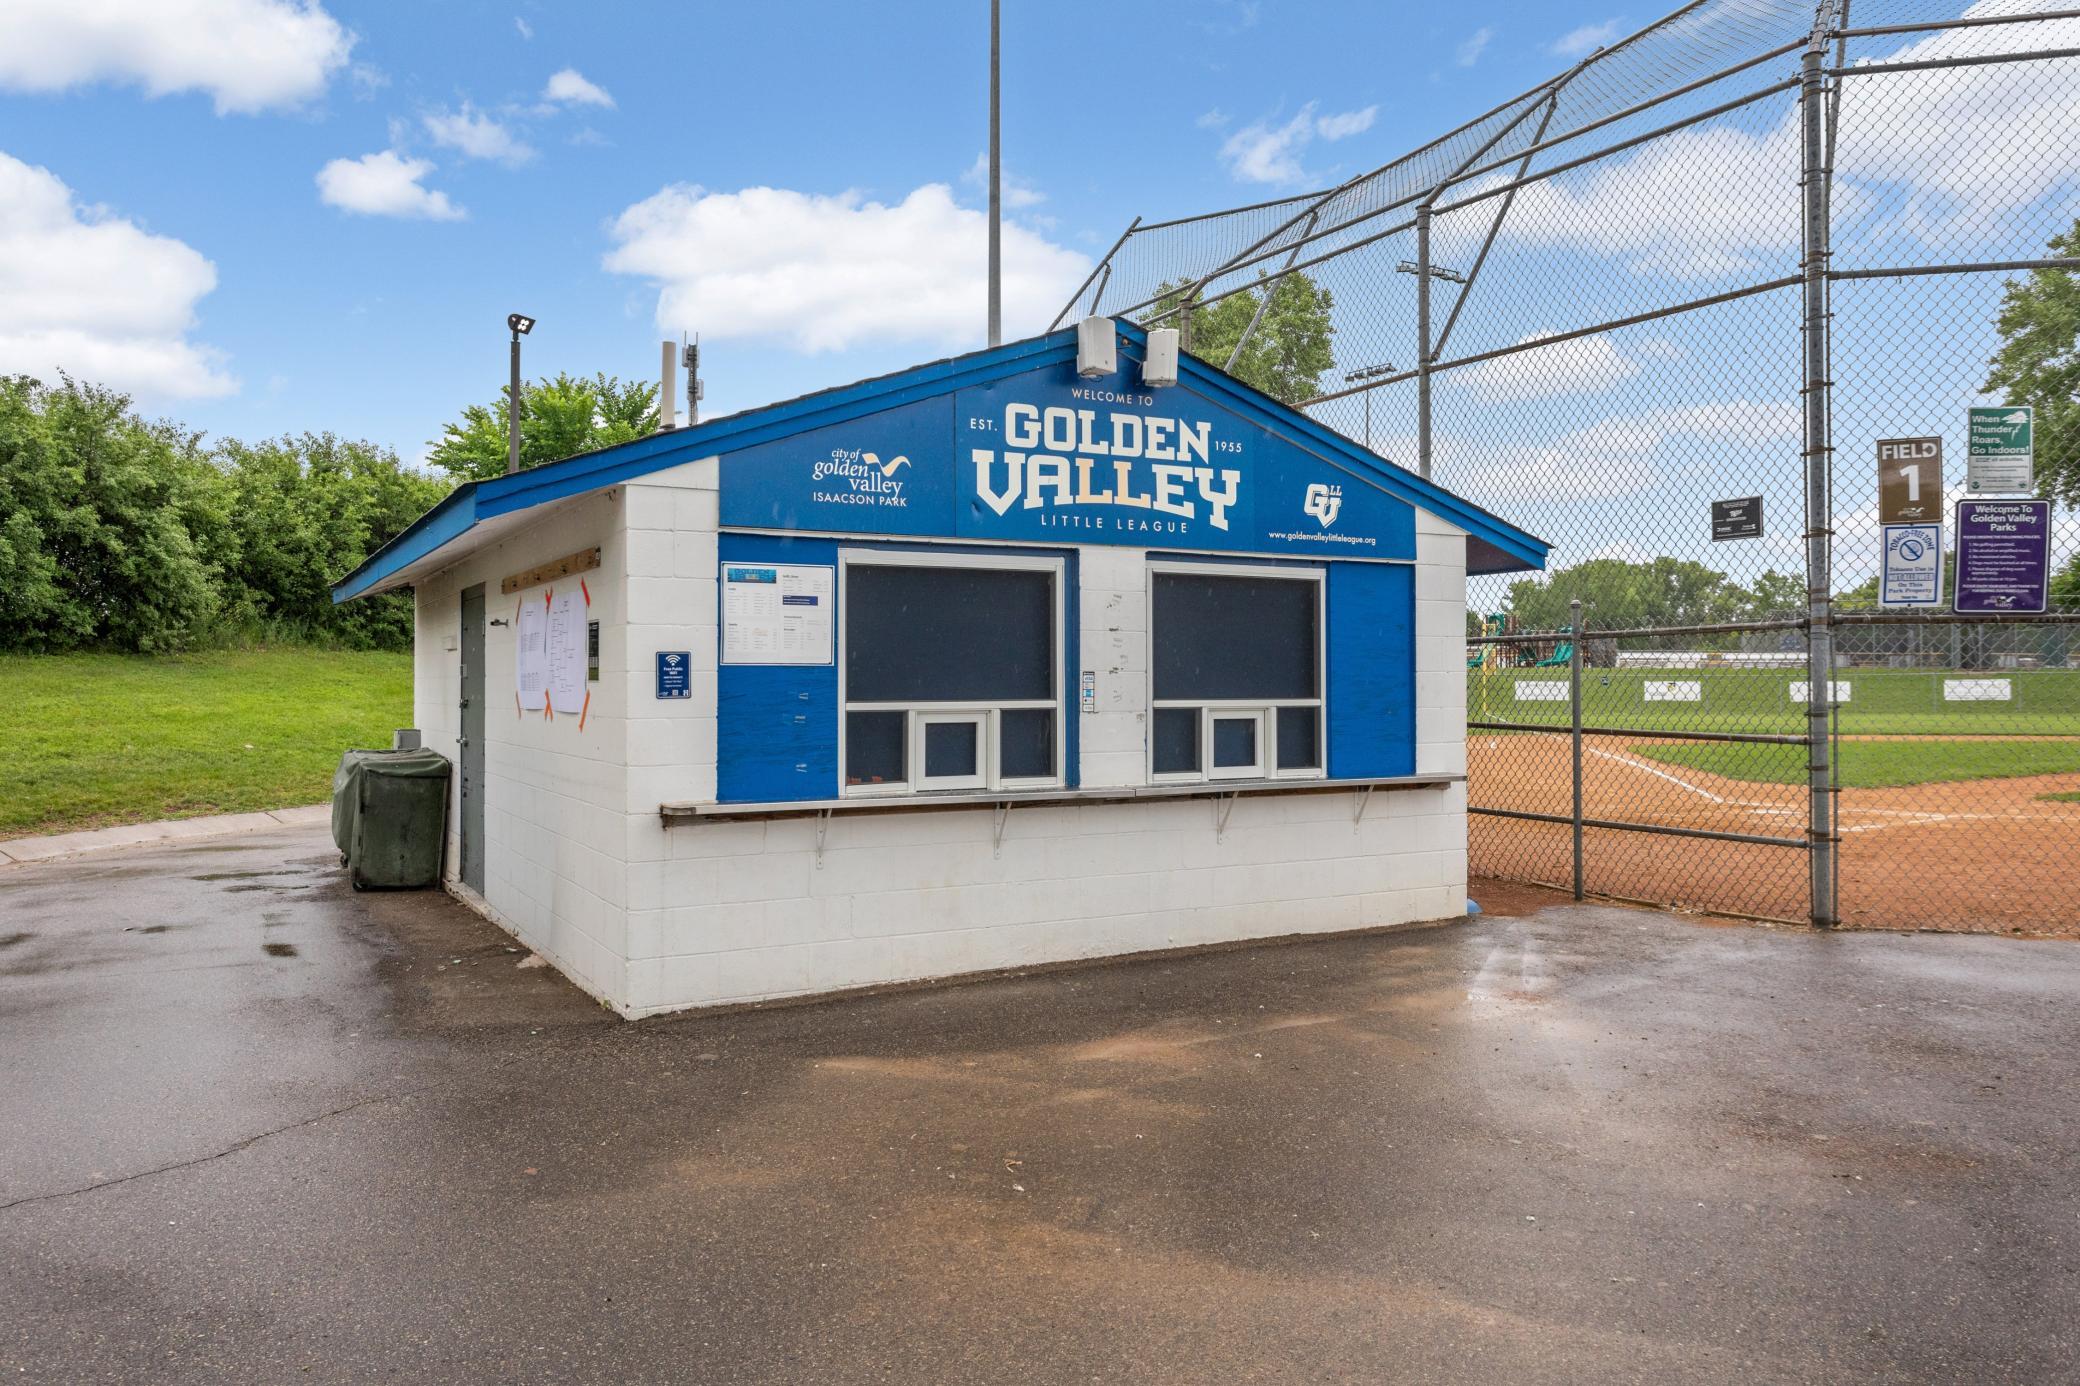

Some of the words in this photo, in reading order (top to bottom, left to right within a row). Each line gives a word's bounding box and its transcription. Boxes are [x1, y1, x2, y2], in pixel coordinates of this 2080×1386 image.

[1072, 388, 1132, 404] WELCOME
[1138, 396, 1153, 406] TO
[970, 418, 998, 432] EST.
[1972, 415, 2000, 423] When
[1005, 402, 1212, 464] GOLDEN
[1215, 440, 1242, 453] 1955
[1882, 442, 1938, 460] FIELD
[1988, 446, 2030, 454] Indoors!
[832, 448, 848, 461] city
[850, 448, 861, 462] of
[812, 458, 868, 480] golden
[848, 472, 904, 500] valley
[972, 449, 1240, 531] VALLEY
[1900, 464, 1920, 502] 1
[813, 491, 874, 505] ISAACSON
[880, 496, 907, 507] PARK
[1974, 505, 2019, 514] Welcome
[2020, 504, 2033, 513] To
[1041, 514, 1103, 529] LITTLE
[1117, 518, 1188, 533] LEAGUE
[1970, 514, 2006, 523] Golden
[2008, 514, 2038, 524] Valley
[1990, 523, 2016, 532] Parks
[1268, 531, 1376, 546] www.goldenvalleylittleleague.org
